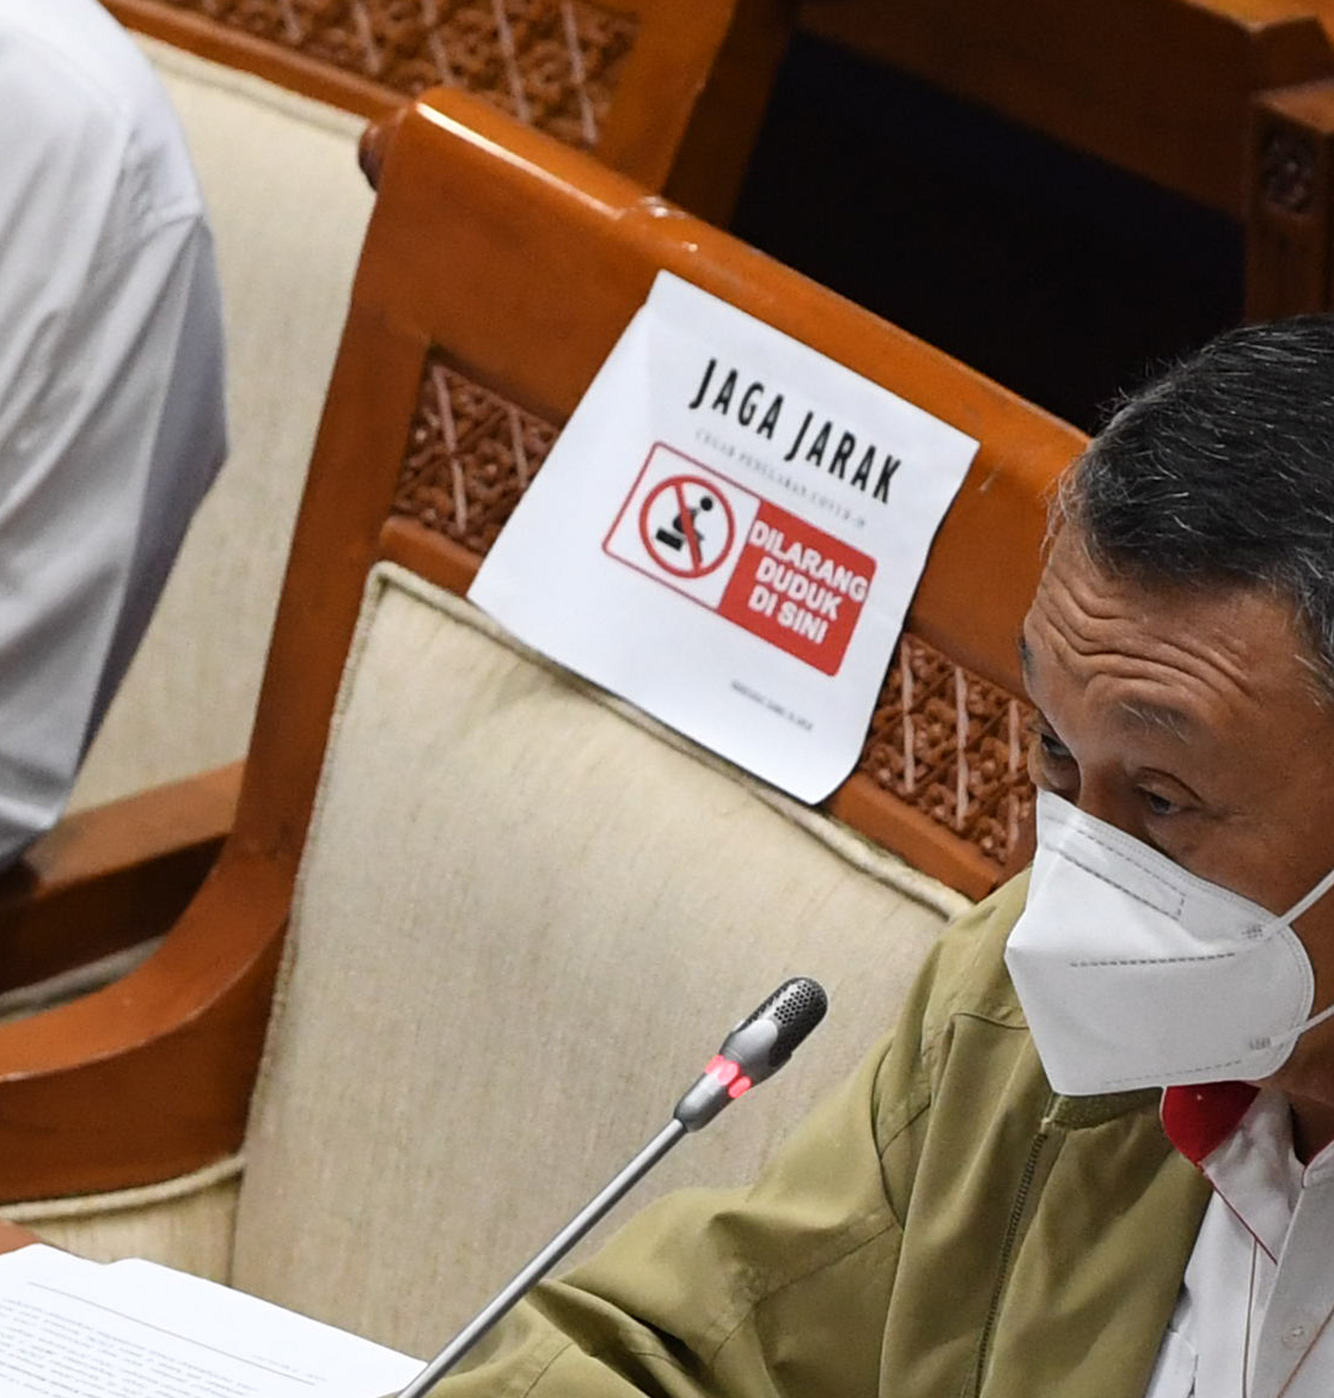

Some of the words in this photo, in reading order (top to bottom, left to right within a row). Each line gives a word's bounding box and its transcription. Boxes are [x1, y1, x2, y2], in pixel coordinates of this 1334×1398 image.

[688, 358, 784, 440] JAGA
[783, 410, 902, 504] JARAK
[749, 519, 868, 603] DILARANG
[755, 556, 843, 622] DUDUK
[747, 584, 779, 618] DI
[777, 600, 830, 645] SINI
